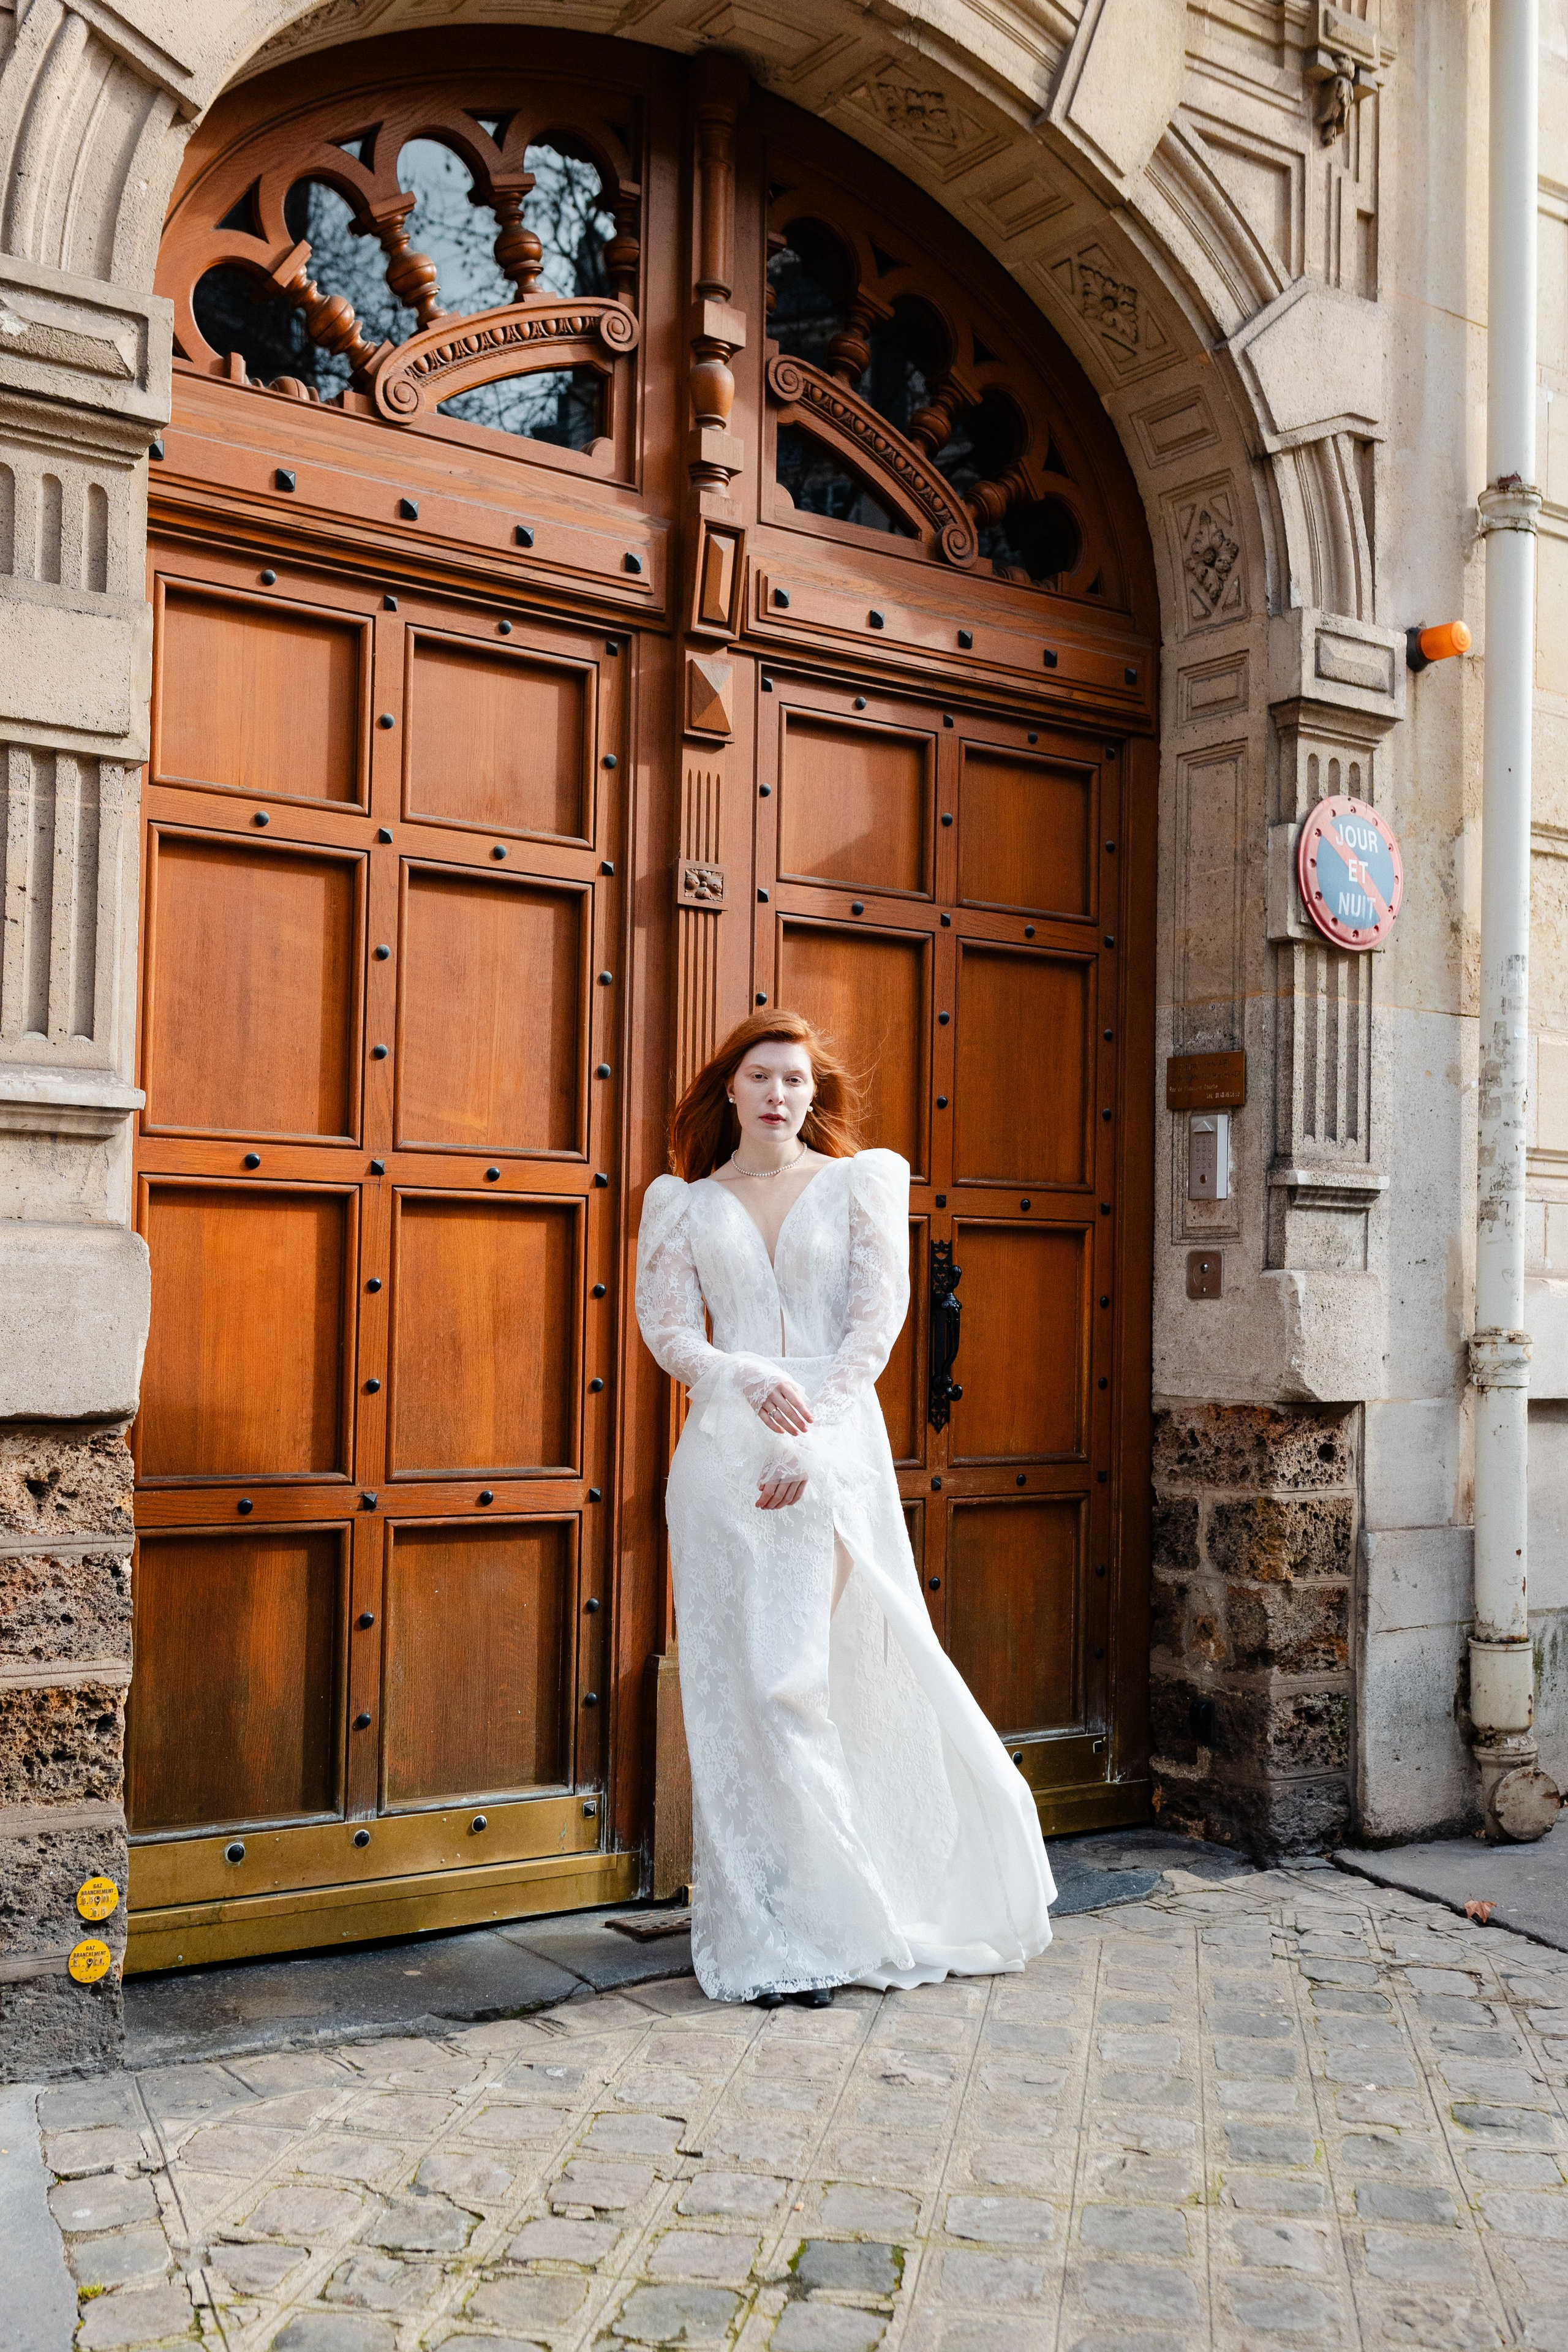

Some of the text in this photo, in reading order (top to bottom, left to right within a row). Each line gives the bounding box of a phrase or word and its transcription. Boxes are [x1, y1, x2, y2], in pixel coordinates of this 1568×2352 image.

[1335, 824, 1379, 853] JOUR
[1348, 859, 1369, 884] ET
[1338, 891, 1376, 921] NUIT
